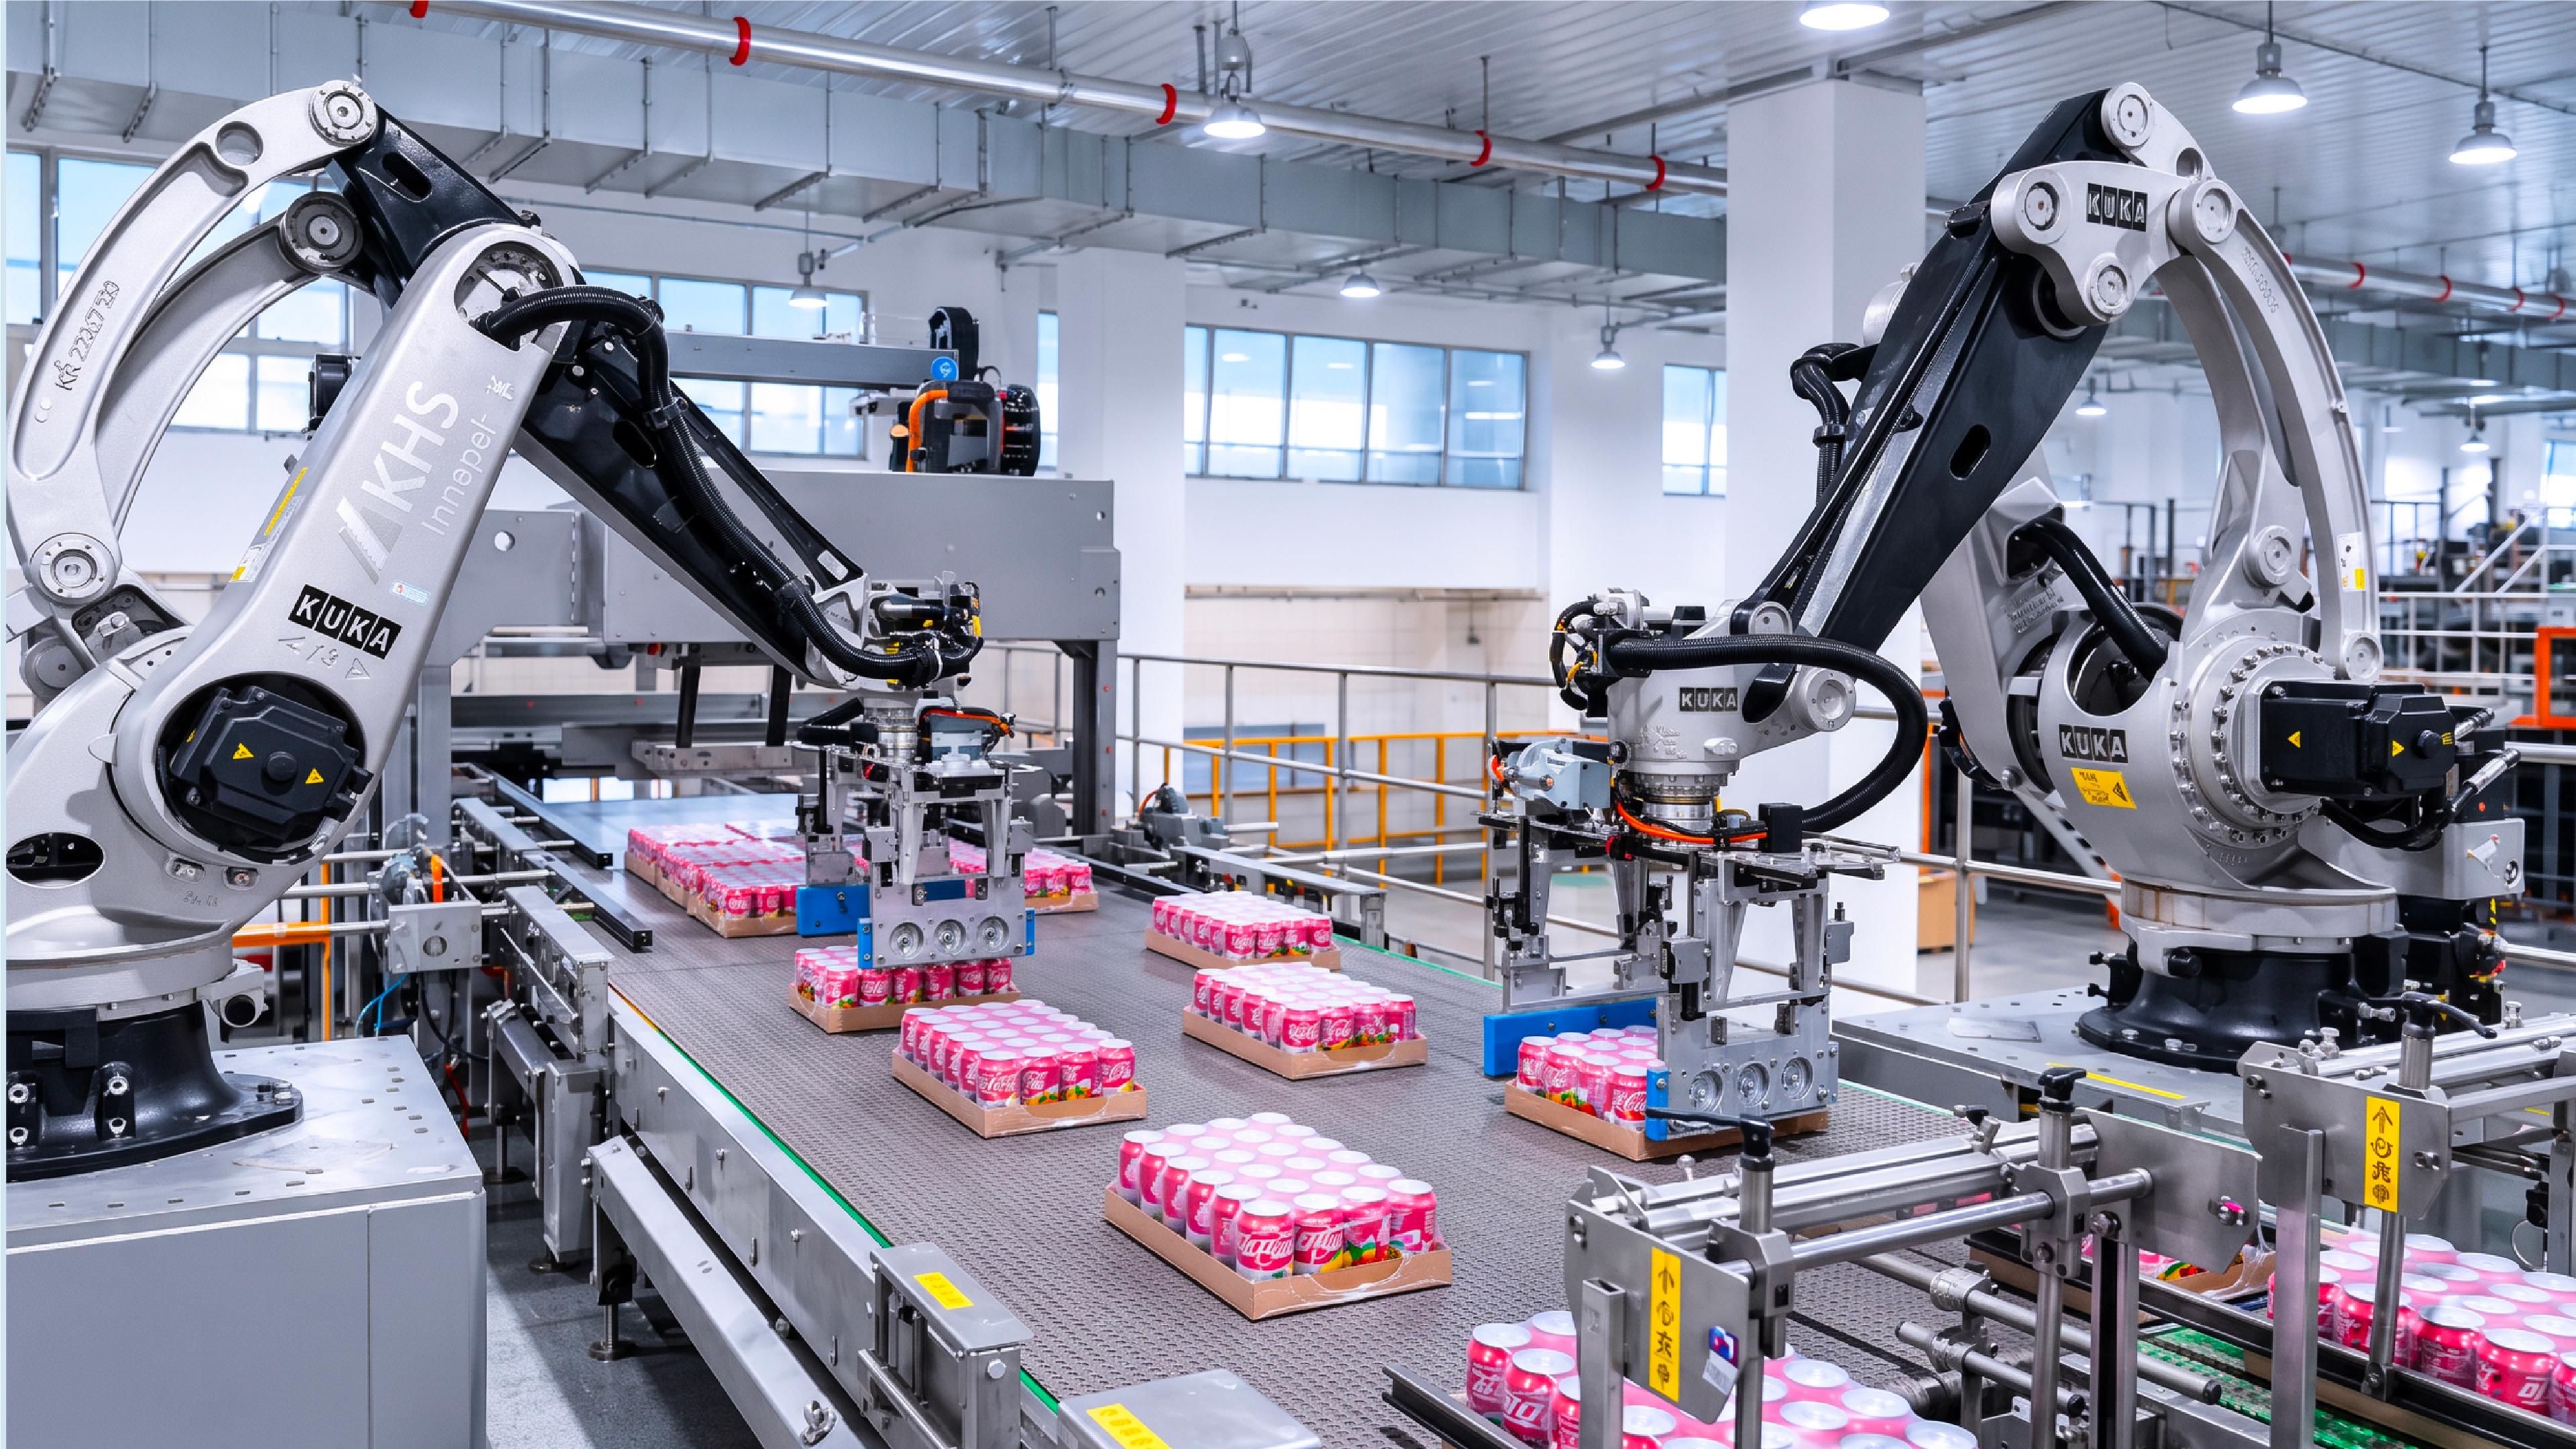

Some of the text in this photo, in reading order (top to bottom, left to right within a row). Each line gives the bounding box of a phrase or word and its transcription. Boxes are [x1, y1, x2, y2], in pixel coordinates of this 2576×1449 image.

[2088, 193, 2145, 223] KUKA
[360, 380, 459, 514] KHS
[296, 594, 391, 652] KUKA
[1681, 692, 1737, 708] KUKA
[2061, 731, 2126, 758] KUKA
